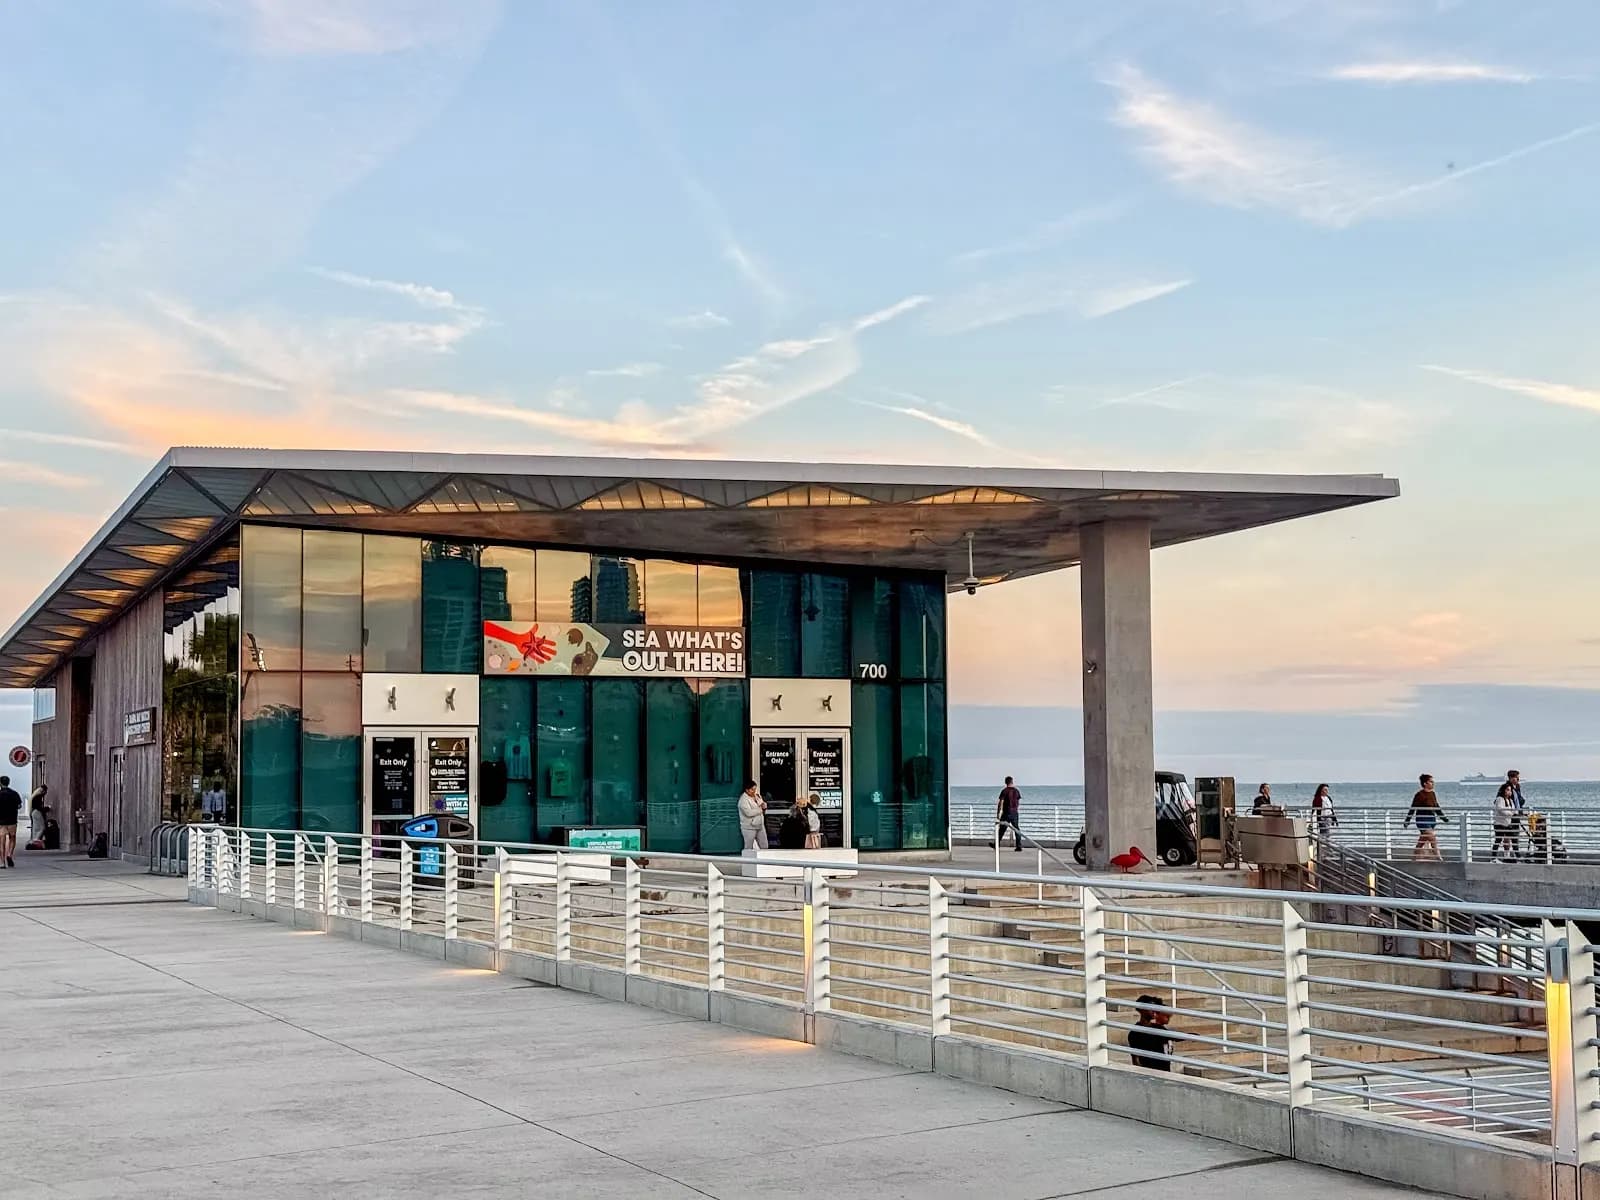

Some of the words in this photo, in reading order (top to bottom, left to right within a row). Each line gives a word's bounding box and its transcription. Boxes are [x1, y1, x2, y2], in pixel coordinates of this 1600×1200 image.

[622, 629, 660, 648] SEA
[666, 630, 743, 650] WHAT'S
[622, 650, 668, 671] OUT
[672, 651, 743, 672] THERE!
[859, 663, 887, 679] 700
[765, 750, 789, 758] Entrance
[812, 750, 836, 758] Entrance
[379, 758, 392, 766] Exit
[392, 758, 407, 767] Only
[434, 758, 447, 766] Exit
[447, 758, 462, 767] Only
[770, 757, 784, 765] Only
[818, 757, 831, 765] Only
